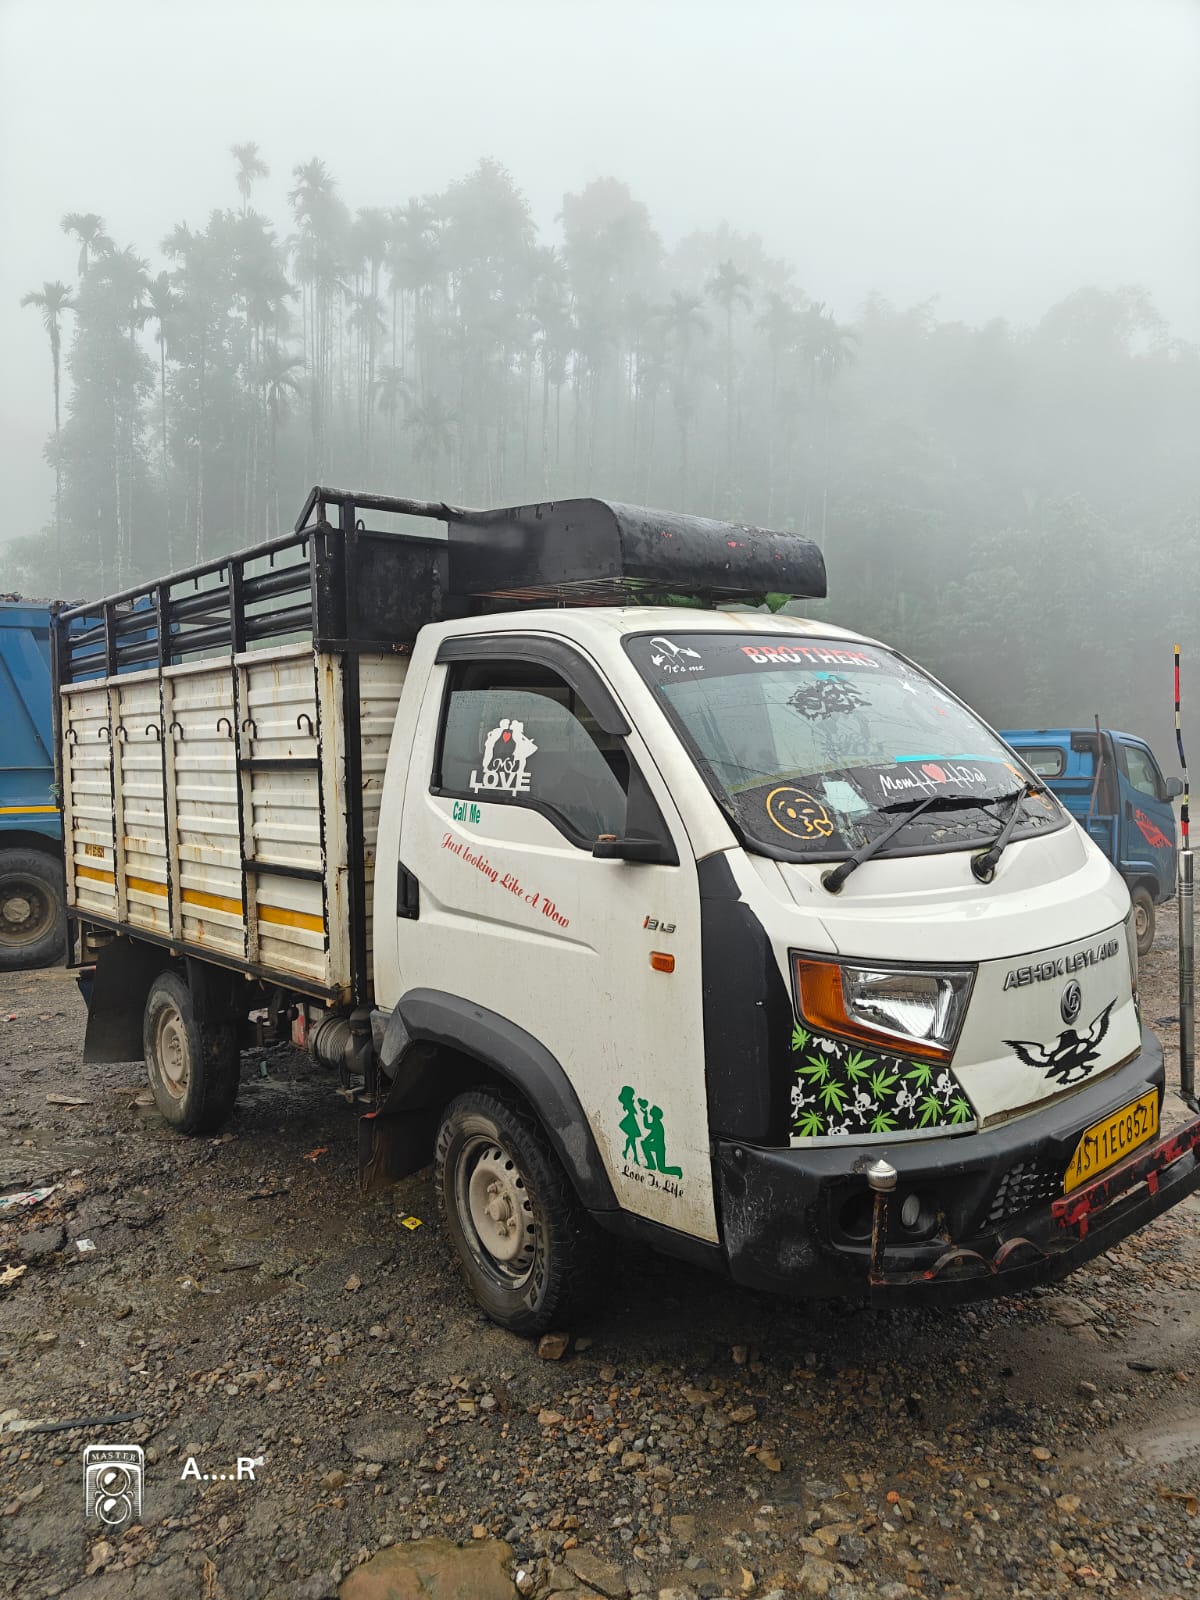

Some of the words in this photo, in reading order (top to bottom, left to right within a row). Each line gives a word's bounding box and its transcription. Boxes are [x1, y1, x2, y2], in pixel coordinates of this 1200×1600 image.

[688, 663, 705, 672] me
[740, 645, 880, 669] BROTHERS
[469, 769, 532, 792] LOVE
[453, 800, 468, 824] Call
[469, 803, 481, 824] Me
[441, 832, 463, 856] Just
[462, 846, 499, 883] looking
[499, 872, 524, 897] Like
[524, 892, 540, 909] A
[541, 897, 570, 928] Wow
[1002, 957, 1064, 992] ASHOK
[1065, 938, 1119, 975] LEYLAND
[621, 1164, 646, 1184] Love
[661, 1179, 684, 1199] Life
